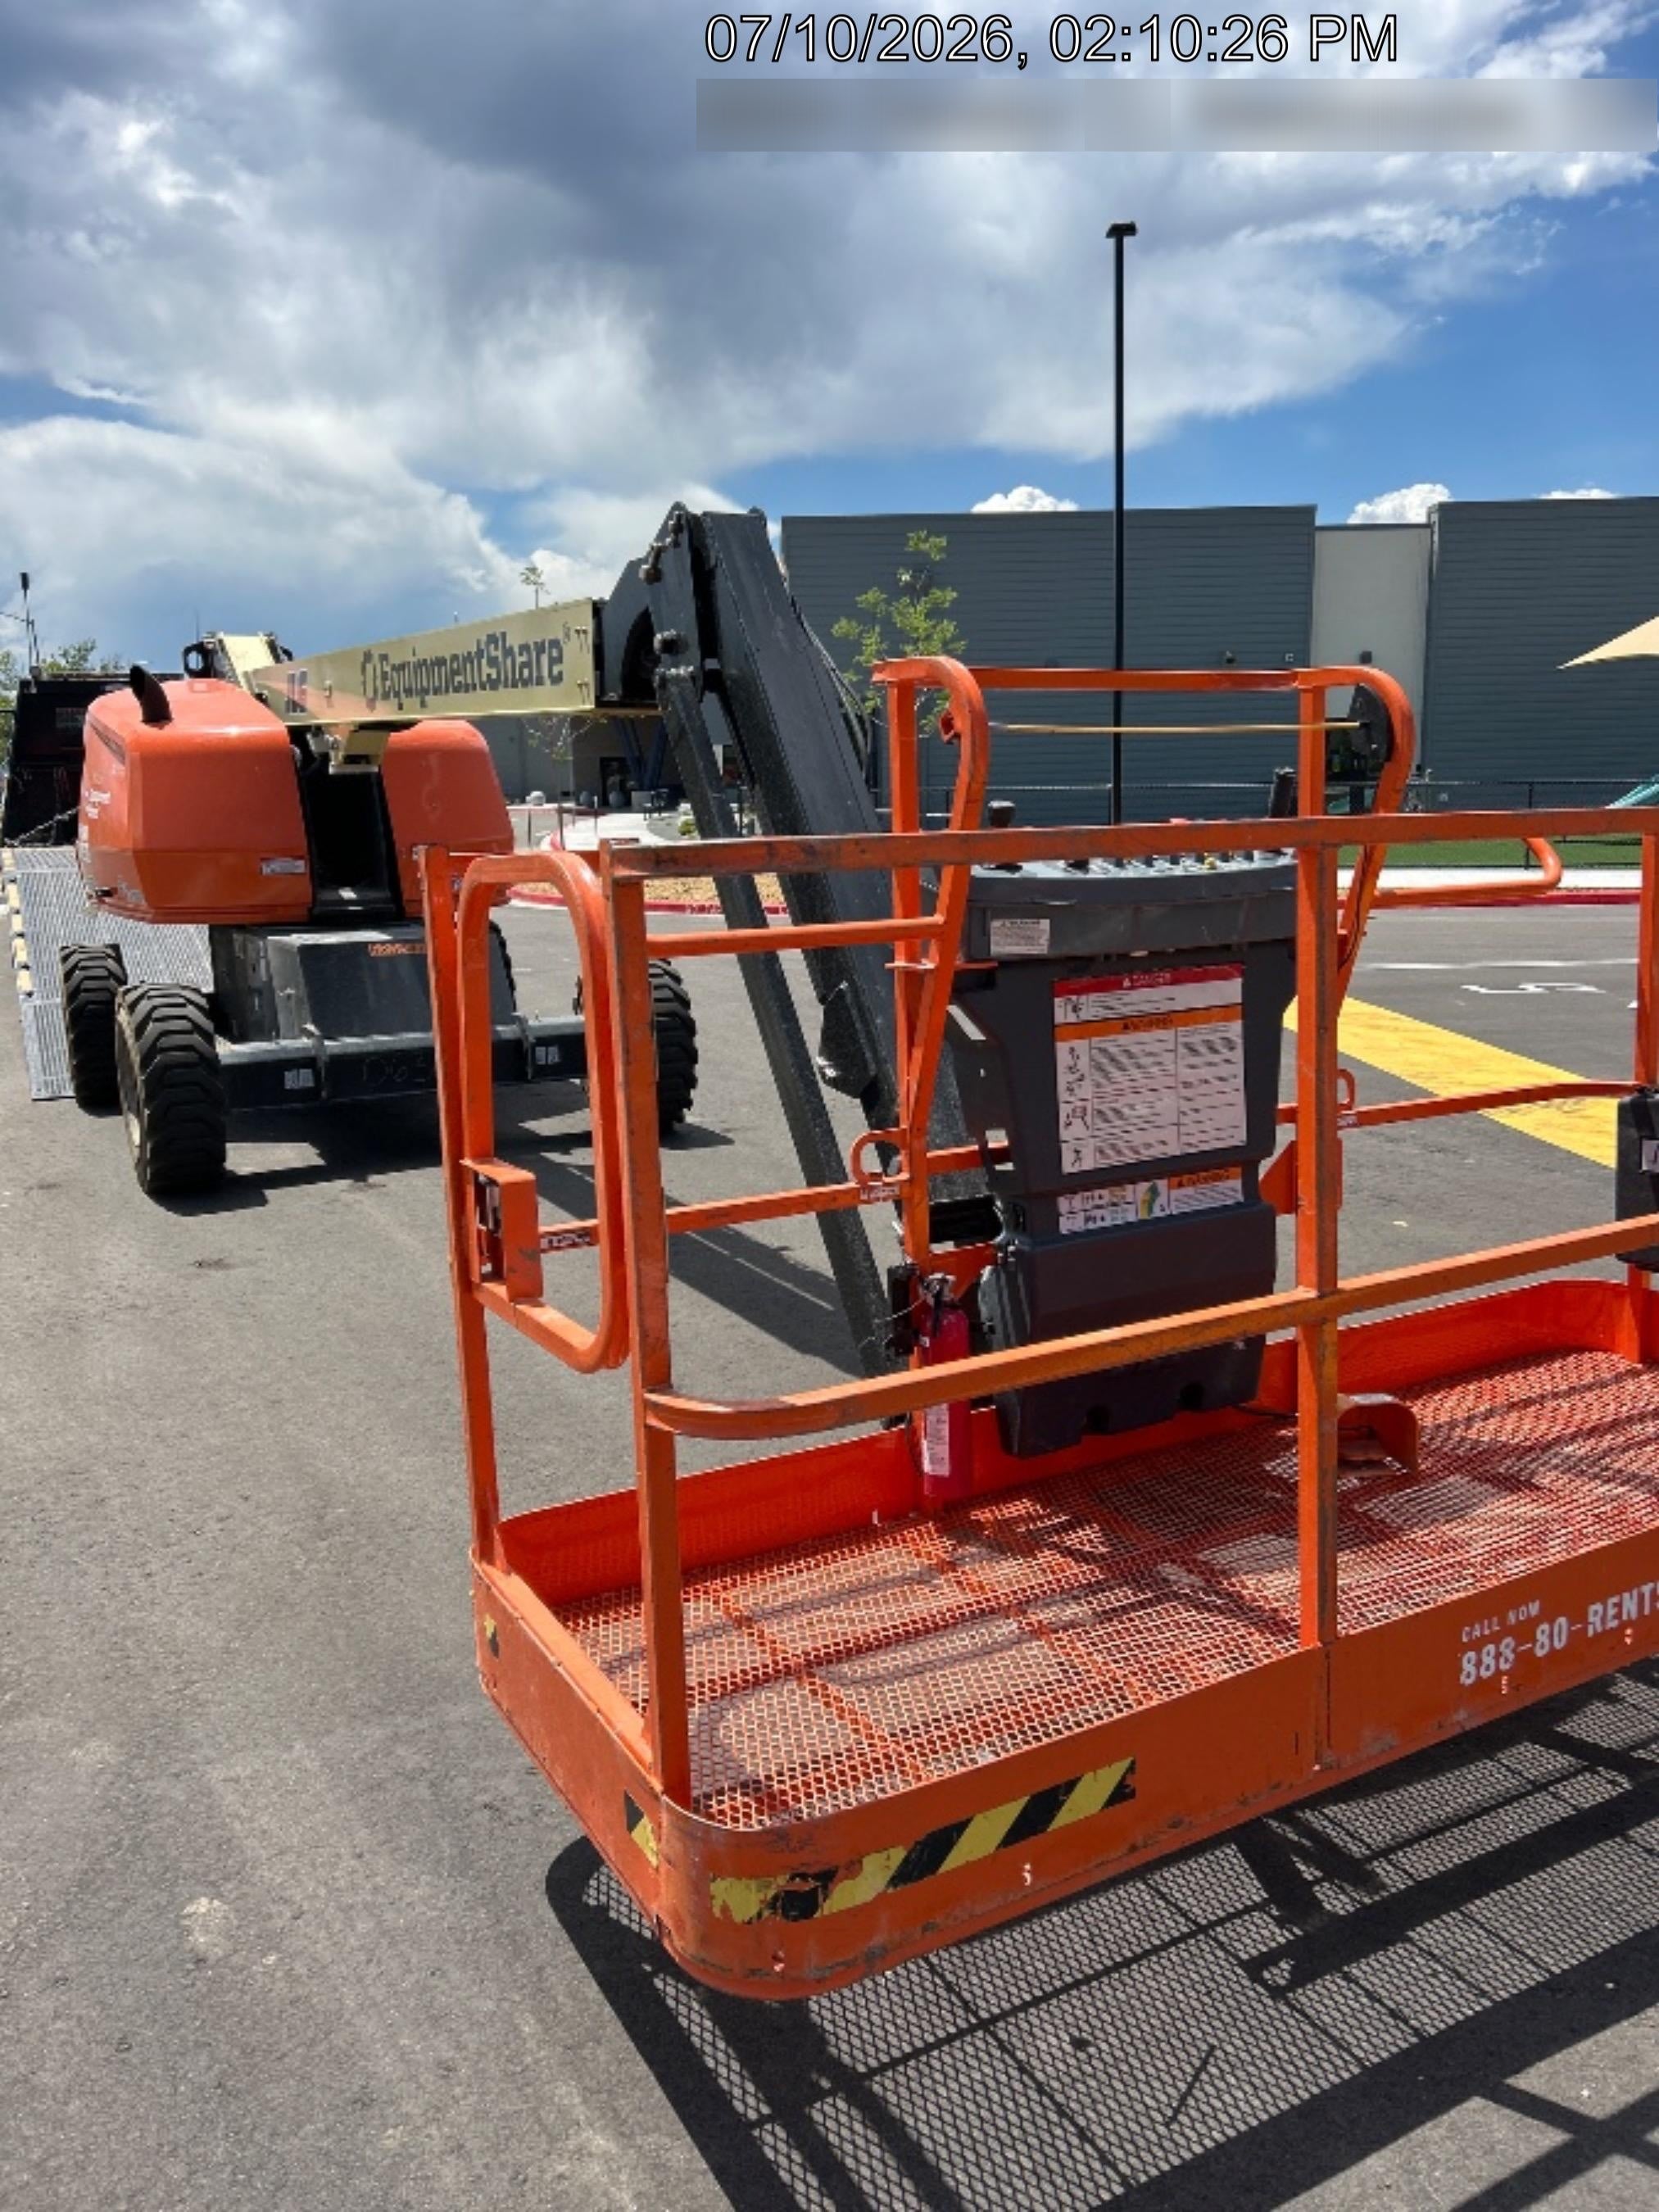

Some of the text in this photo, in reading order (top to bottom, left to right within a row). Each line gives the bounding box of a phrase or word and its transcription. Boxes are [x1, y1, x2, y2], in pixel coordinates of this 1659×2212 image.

[379, 630, 564, 711] EquipmentShare
[1459, 1581, 1659, 1686] 888-80-RENT
[1462, 1599, 1540, 1643] CALL NOW
